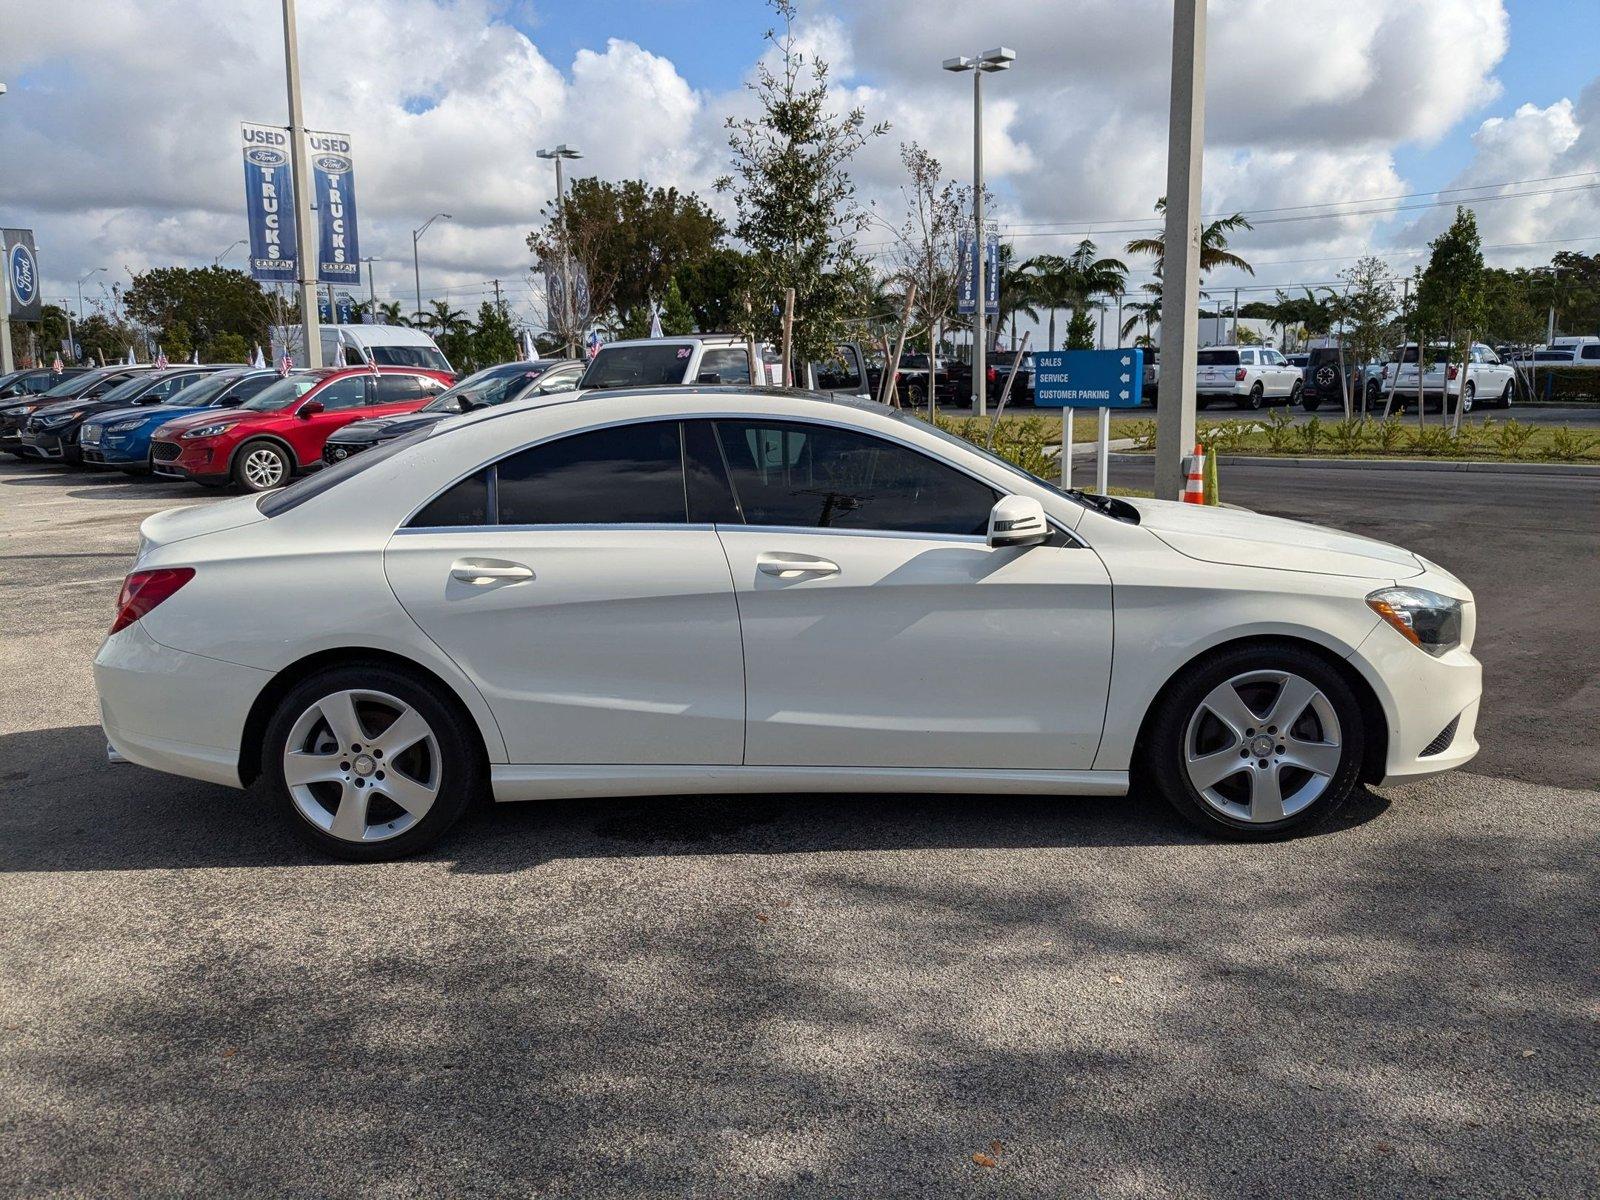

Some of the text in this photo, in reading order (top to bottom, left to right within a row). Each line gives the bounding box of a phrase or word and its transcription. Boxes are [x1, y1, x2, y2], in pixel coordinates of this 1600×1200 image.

[243, 128, 286, 146] USED
[310, 137, 350, 153] USED
[261, 167, 280, 259] TRUCKS
[327, 174, 345, 263] TRUCKS
[15, 256, 33, 292] Ford
[1040, 358, 1062, 367] SALES
[1040, 373, 1069, 383] SERVICE
[1039, 390, 1110, 400] CUSTOMER PARKING
